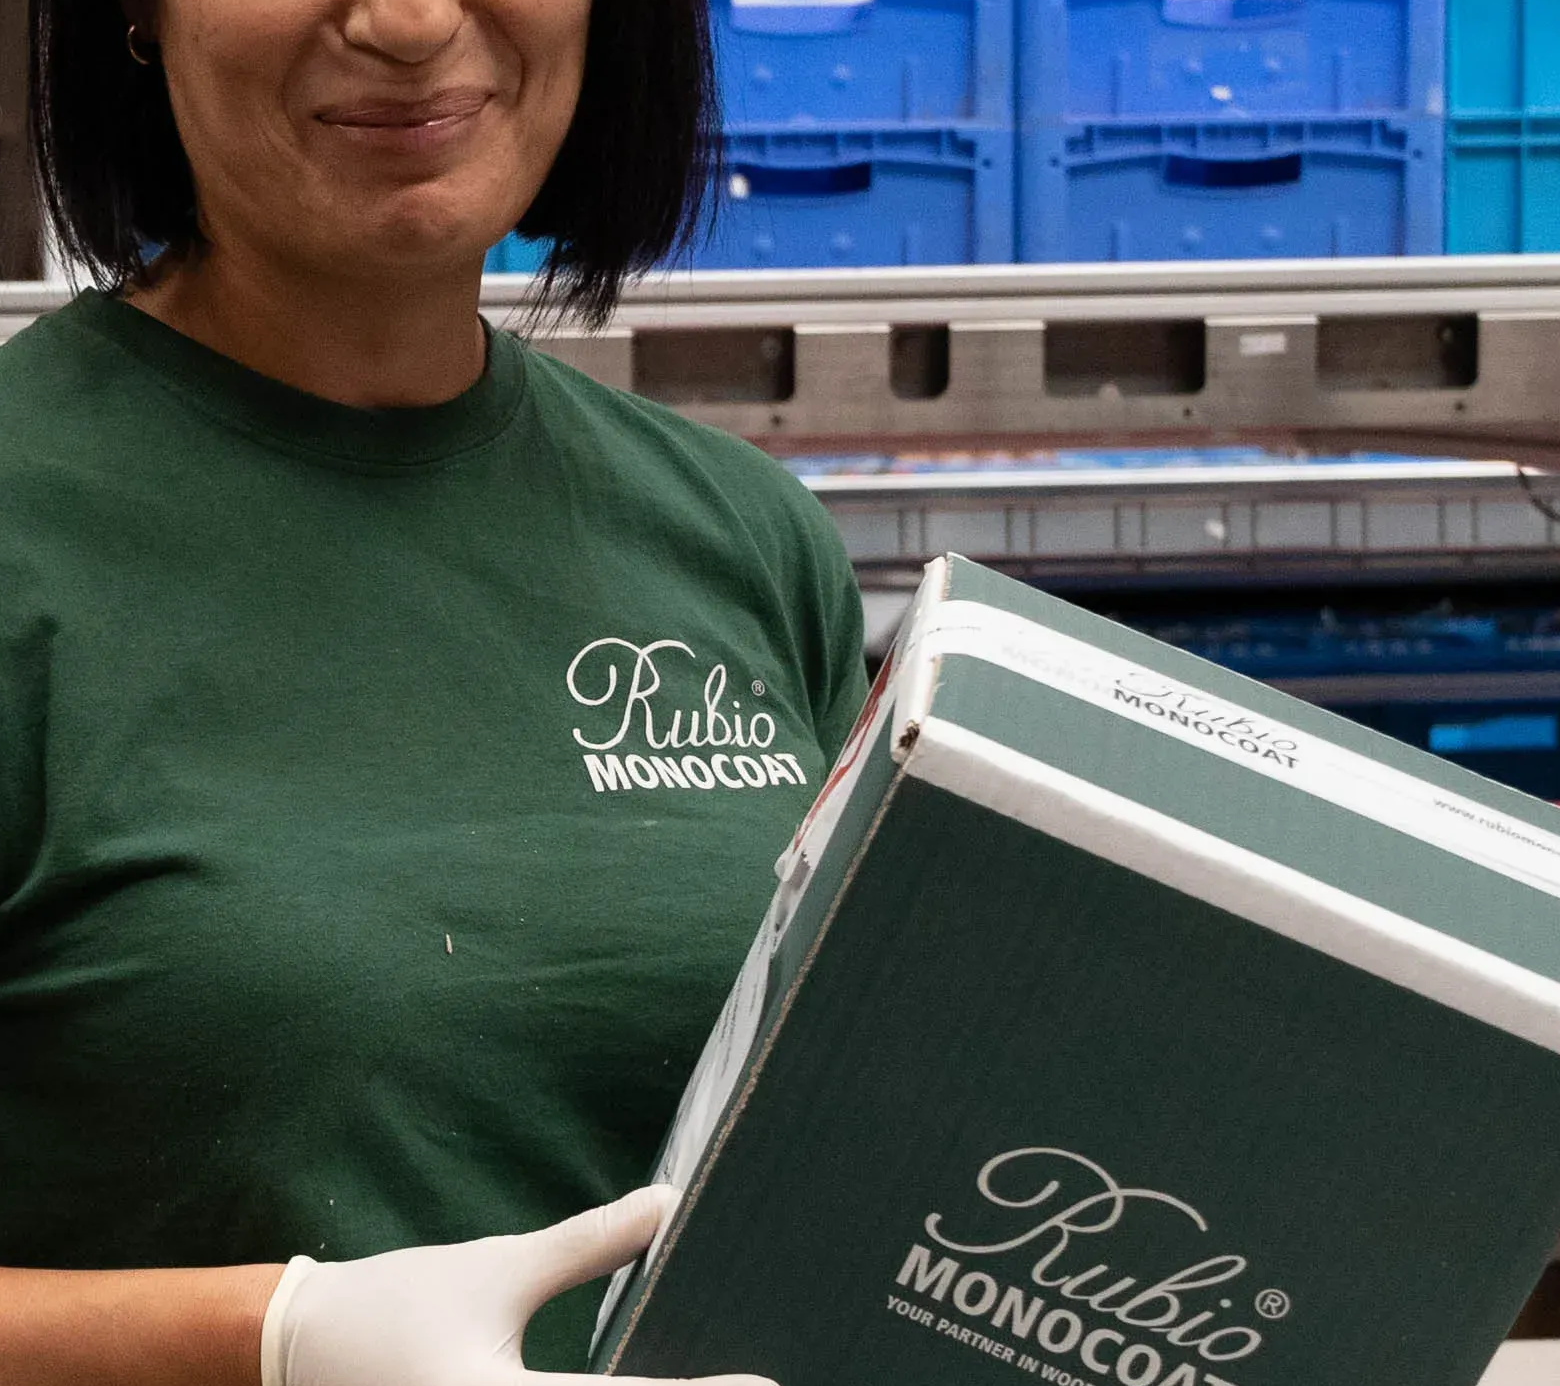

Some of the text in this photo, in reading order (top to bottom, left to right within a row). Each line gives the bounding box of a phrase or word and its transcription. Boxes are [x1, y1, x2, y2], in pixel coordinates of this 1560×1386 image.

[1112, 687, 1300, 771] MONOCOAT
[582, 752, 808, 793] MONOCOAT
[886, 1294, 935, 1328] YOUR
[935, 1317, 1016, 1365] PARTNER
[1016, 1353, 1041, 1375] IN
